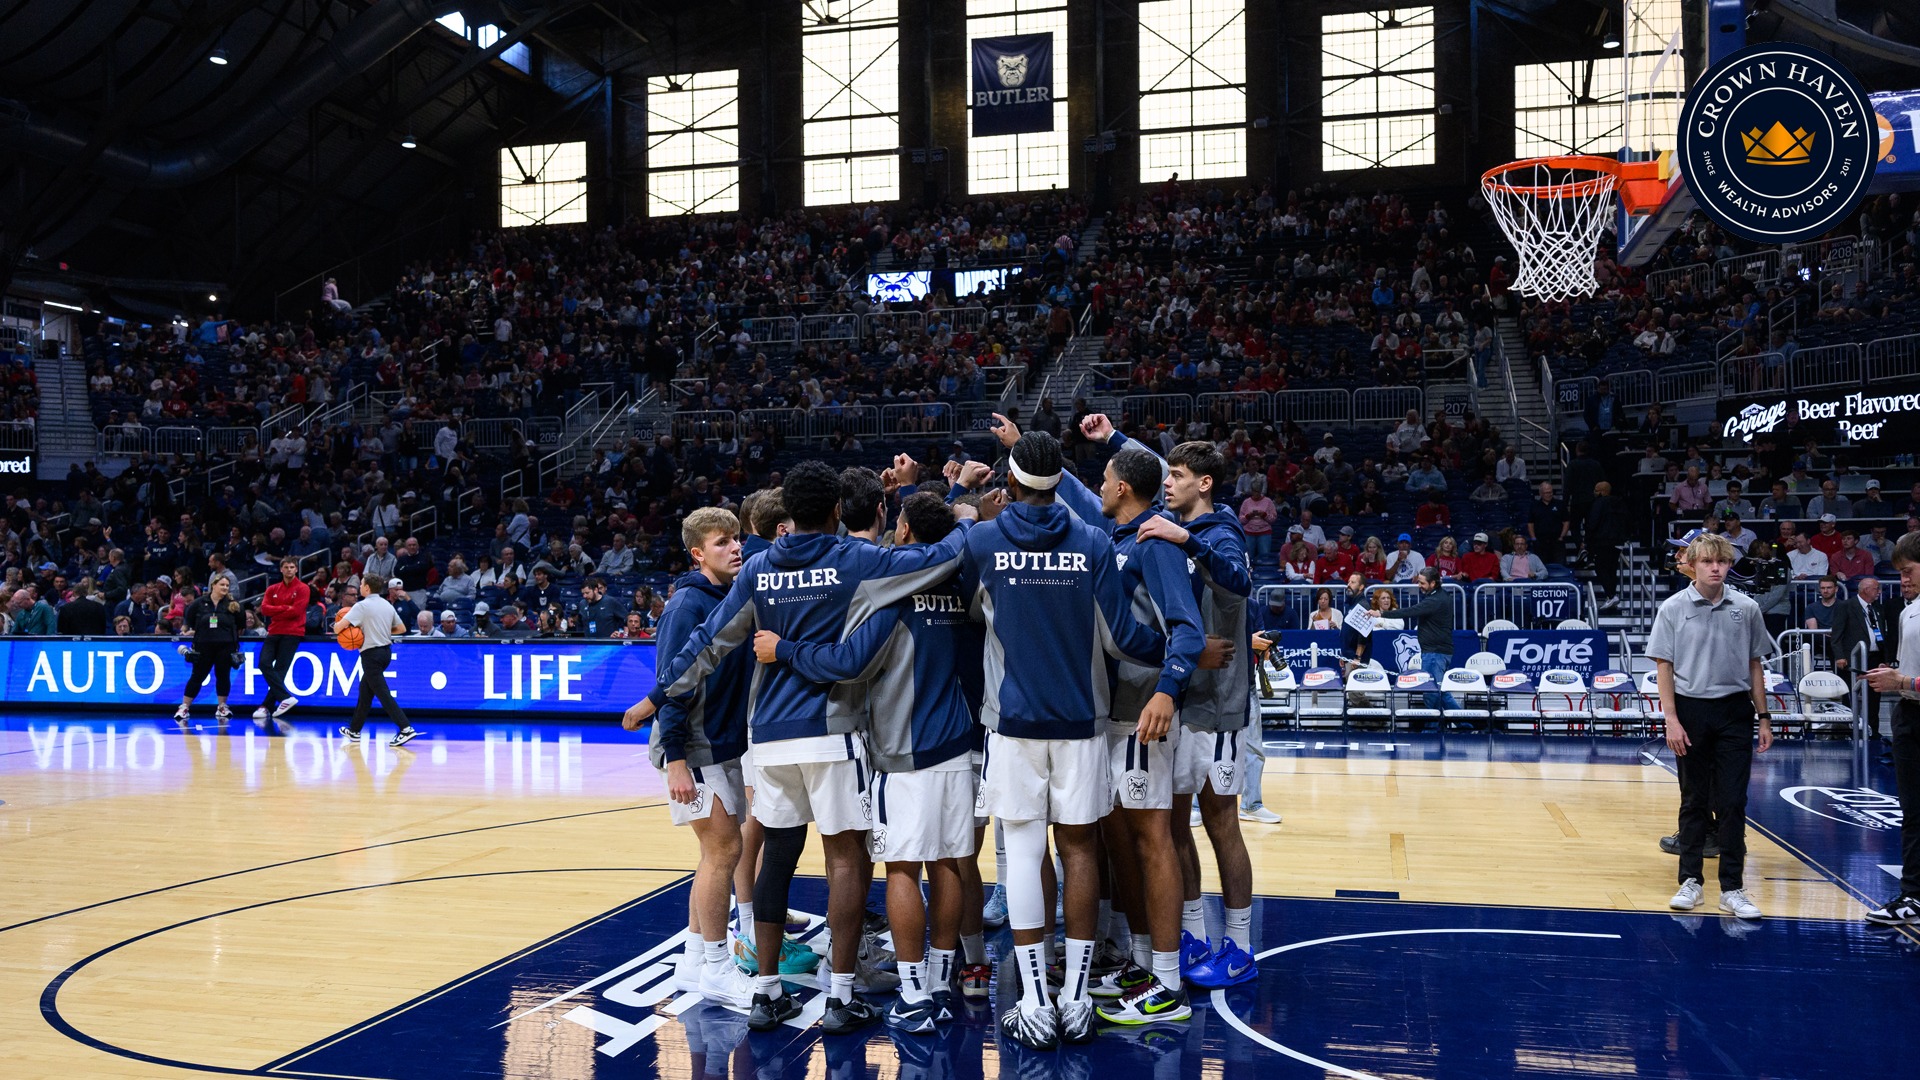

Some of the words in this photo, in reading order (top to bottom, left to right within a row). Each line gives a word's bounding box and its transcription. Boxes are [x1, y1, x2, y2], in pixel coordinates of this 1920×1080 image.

[976, 87, 1050, 107] BUTLER
[1831, 246, 1852, 260] 208
[1560, 389, 1579, 402] 208
[1445, 402, 1467, 415] 207
[1797, 399, 1840, 420] Beer
[972, 418, 991, 430] 206
[539, 432, 558, 443] 205
[634, 428, 653, 440] 206
[993, 552, 1089, 572] BUTLER
[756, 567, 842, 591] BUTLER
[1532, 590, 1568, 598] SECTION
[1536, 600, 1565, 618] 107
[1504, 638, 1594, 664] Forté
[27, 650, 165, 695] AUTO
[484, 654, 582, 701] LIFE
